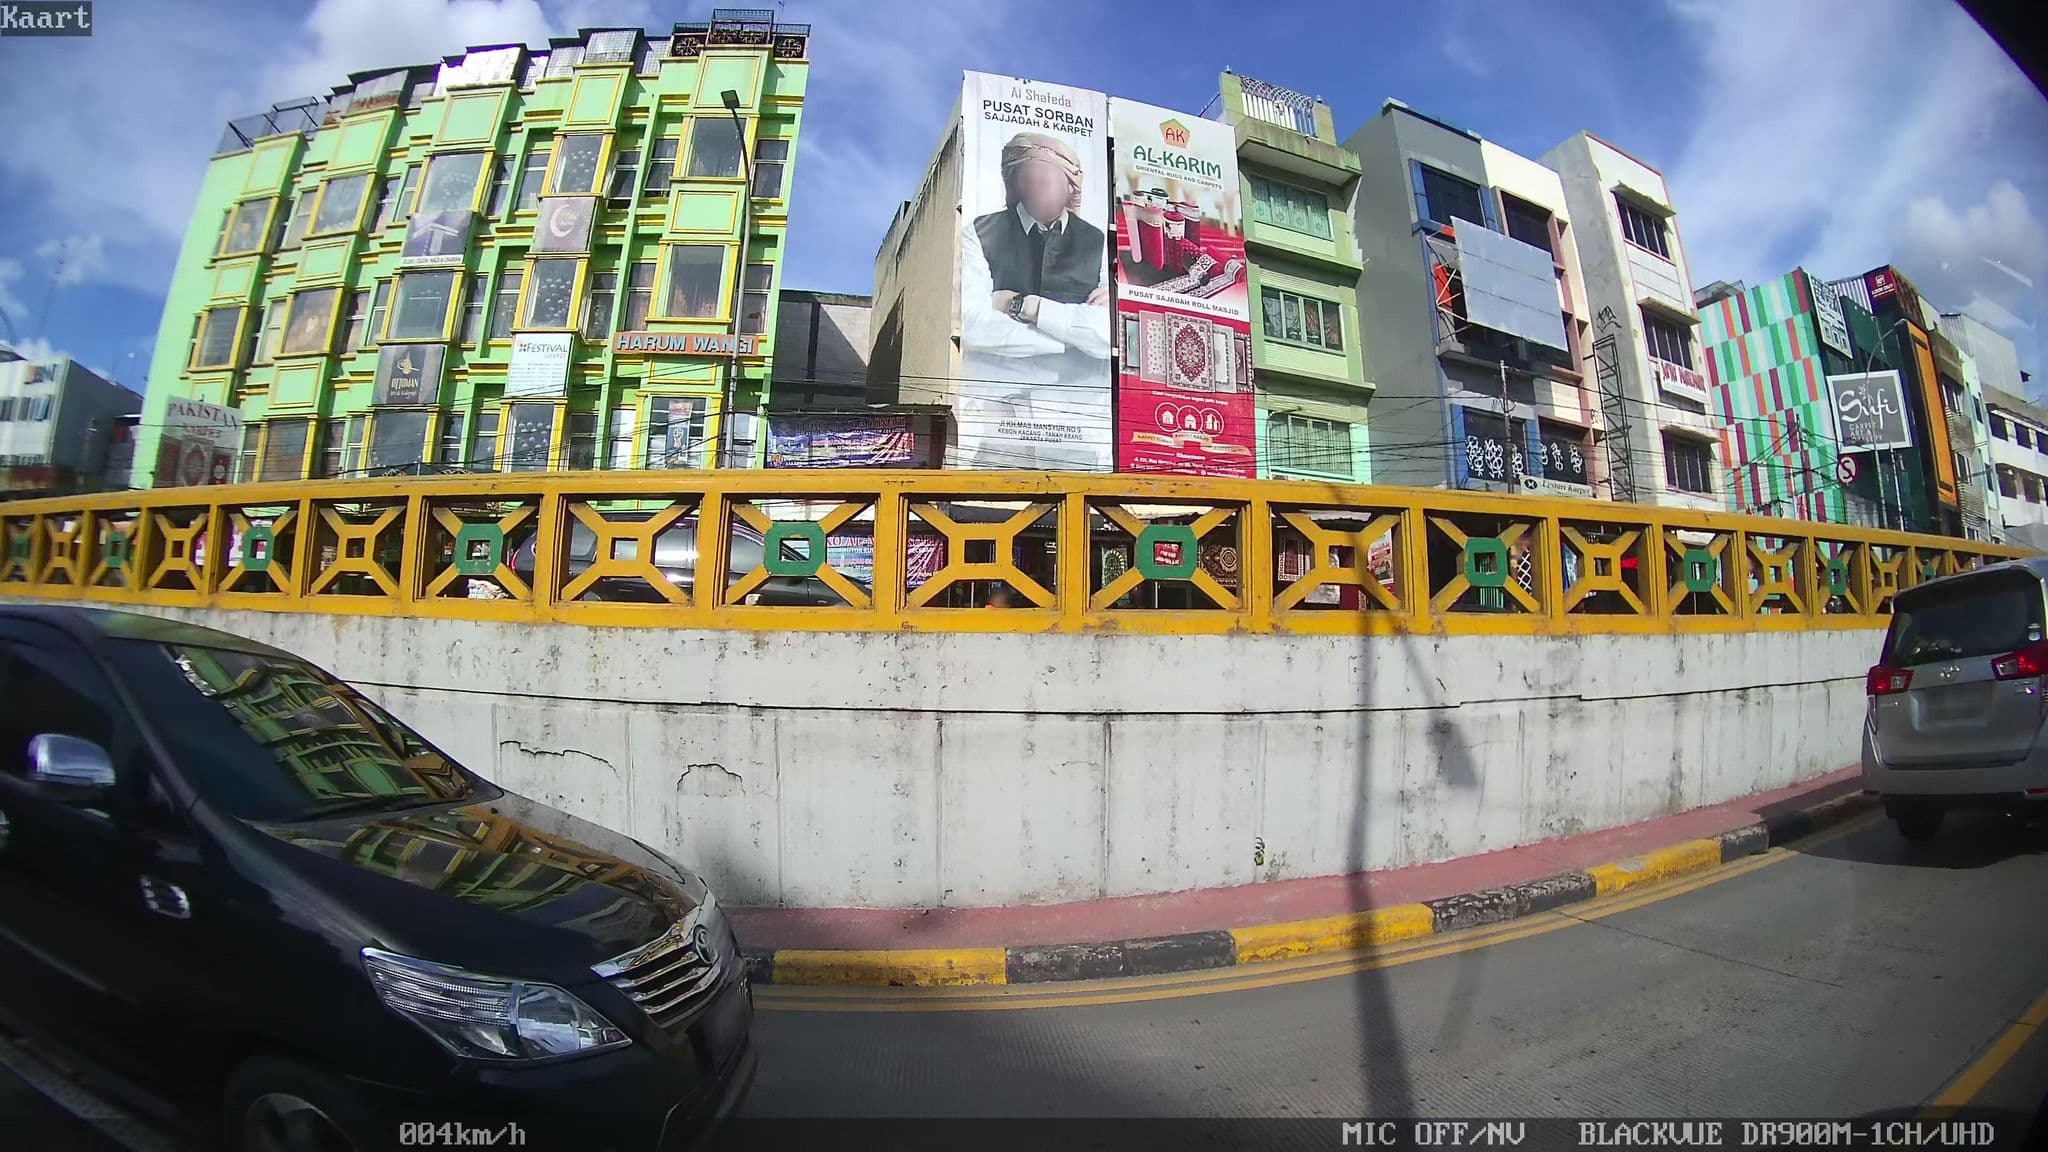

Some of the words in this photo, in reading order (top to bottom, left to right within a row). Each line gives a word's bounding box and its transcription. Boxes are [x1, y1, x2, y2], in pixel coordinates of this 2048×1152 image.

[1025, 88, 1071, 108] Shafeda
[983, 99, 1031, 116] PUSAT
[1034, 107, 1094, 129] SORBAN
[984, 111, 1041, 128] SAJJADAH
[1042, 120, 1050, 129] &
[1052, 122, 1093, 138] KARPET
[1165, 127, 1185, 144] AK
[1133, 145, 1222, 180] AL-KARIM
[1135, 164, 1165, 176] ORIENTAL
[1166, 171, 1182, 180] RUGS
[1128, 289, 1154, 300] PUSAT
[1155, 295, 1190, 307] SAJADAH
[1191, 302, 1211, 311] ROLL
[1212, 304, 1240, 317] MASJID
[616, 334, 687, 352] HARUM
[693, 336, 755, 354] WANGI
[168, 402, 238, 429] PAKISTAN
